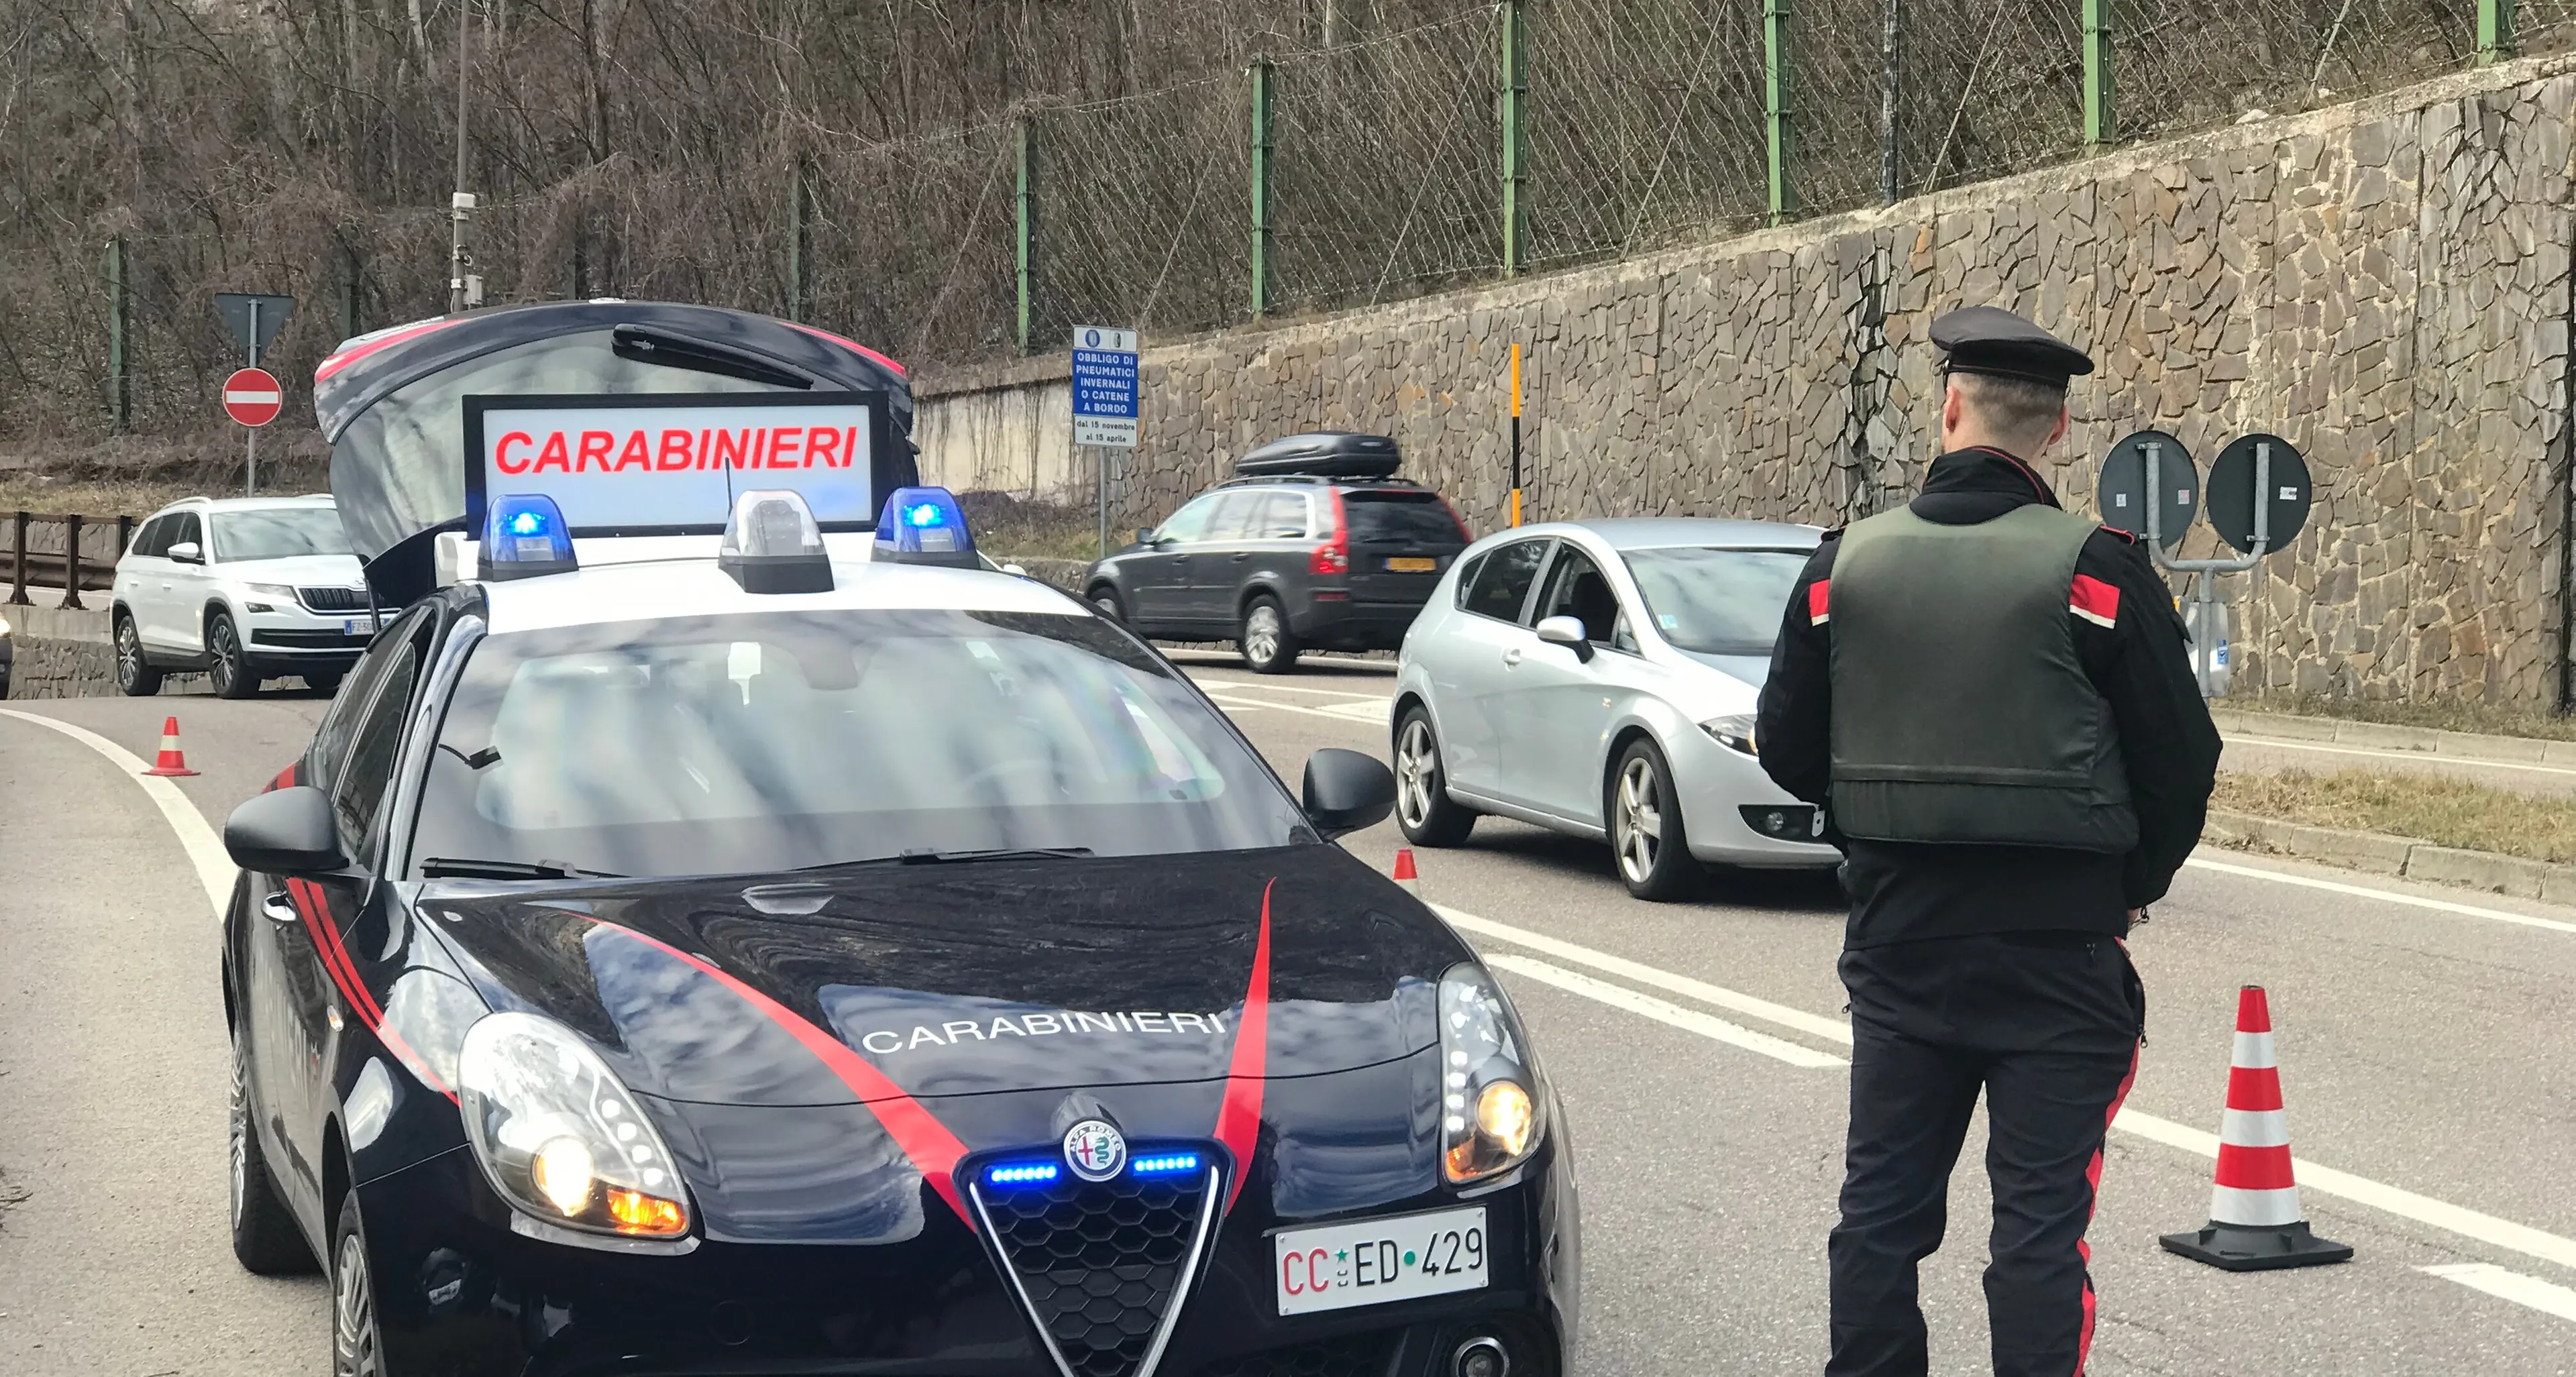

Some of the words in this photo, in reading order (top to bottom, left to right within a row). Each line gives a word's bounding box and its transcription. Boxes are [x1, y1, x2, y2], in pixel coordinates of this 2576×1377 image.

[1077, 352, 1119, 364] OBBLIGO
[1124, 355, 1133, 365] DI
[1076, 364, 1134, 378] PNEUMATICI
[1081, 377, 1130, 389] INVERNALI
[1081, 390, 1088, 399] O
[1092, 390, 1130, 402] CATENE
[1083, 402, 1090, 411] A
[1094, 402, 1128, 413] BORDO
[1091, 421, 1099, 429] 15
[1102, 423, 1135, 431] novembre
[1095, 433, 1104, 441] 15
[1107, 435, 1127, 443] aprile
[495, 426, 857, 474] CARABINIERI
[862, 1011, 1226, 1054] CARABINIERI
[1069, 1129, 1087, 1152] ALFA
[1283, 1248, 1329, 1296] CC
[1354, 1240, 1399, 1287] ED
[1421, 1227, 1483, 1276] 429
